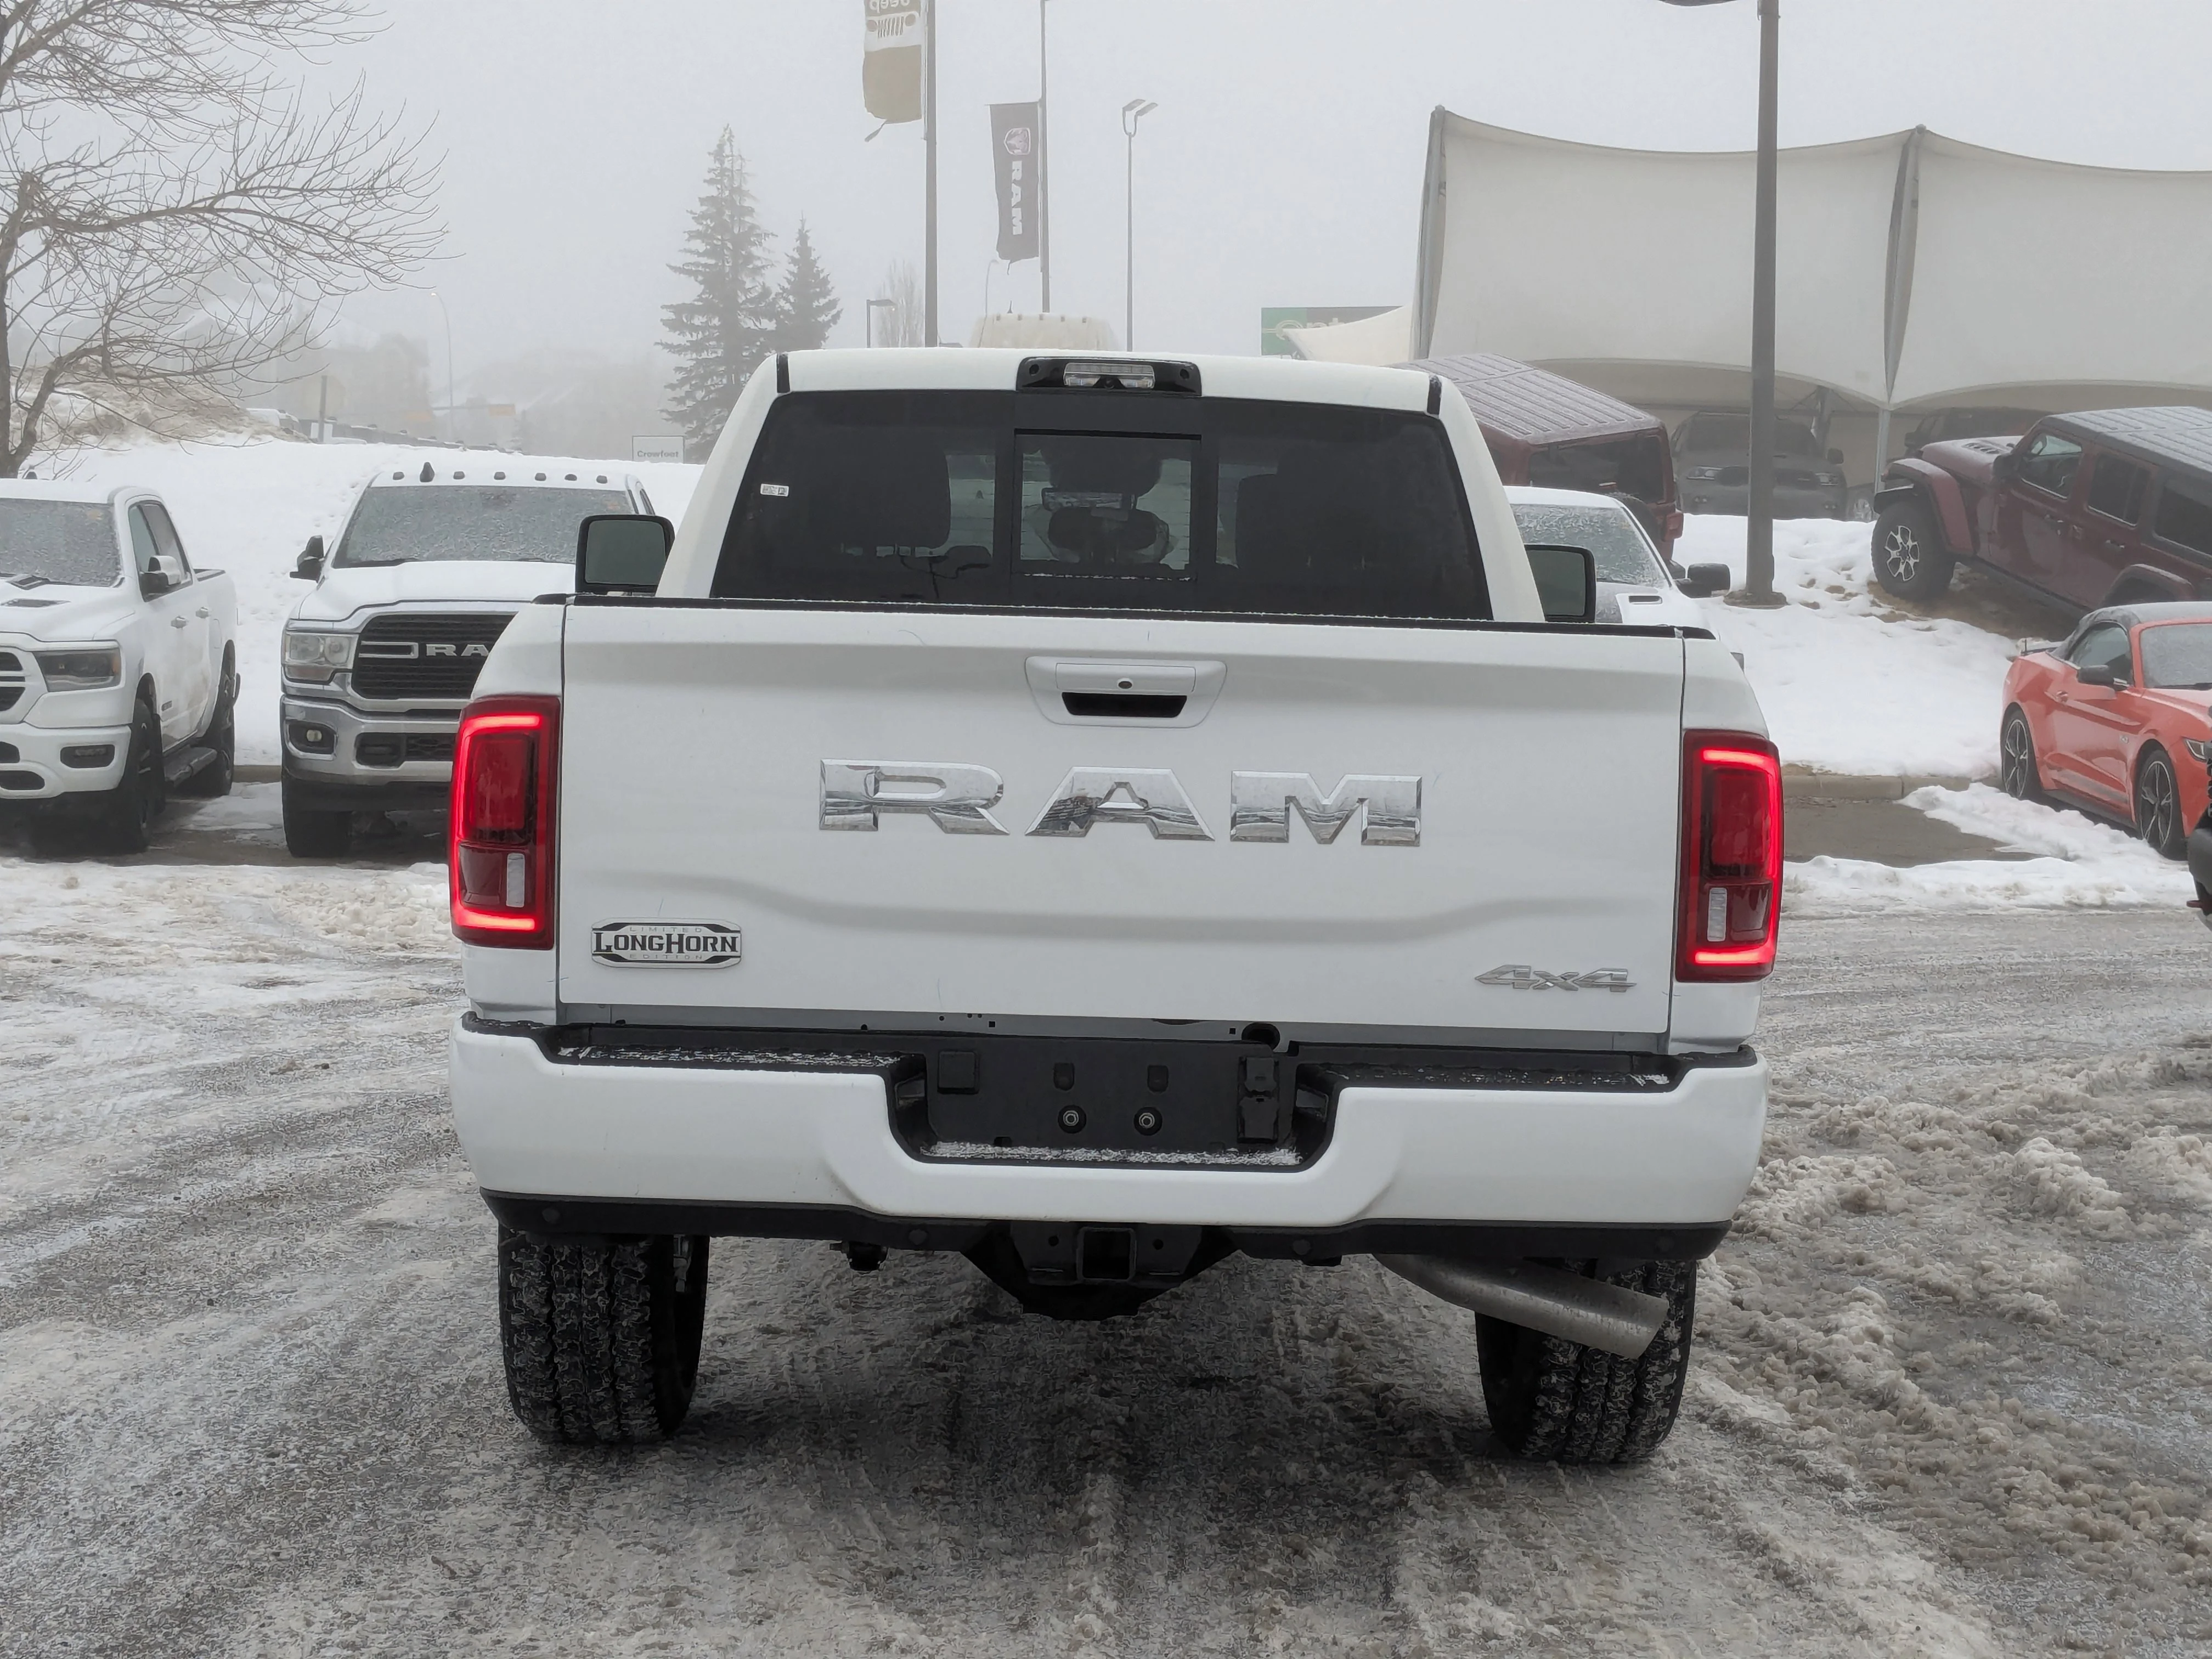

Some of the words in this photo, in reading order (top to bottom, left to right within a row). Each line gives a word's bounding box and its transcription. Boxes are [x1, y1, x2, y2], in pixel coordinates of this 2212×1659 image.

[1012, 161, 1022, 235] RAM
[426, 644, 490, 657] RA
[819, 759, 1422, 847] RAM
[1474, 964, 1638, 993] 4x4
